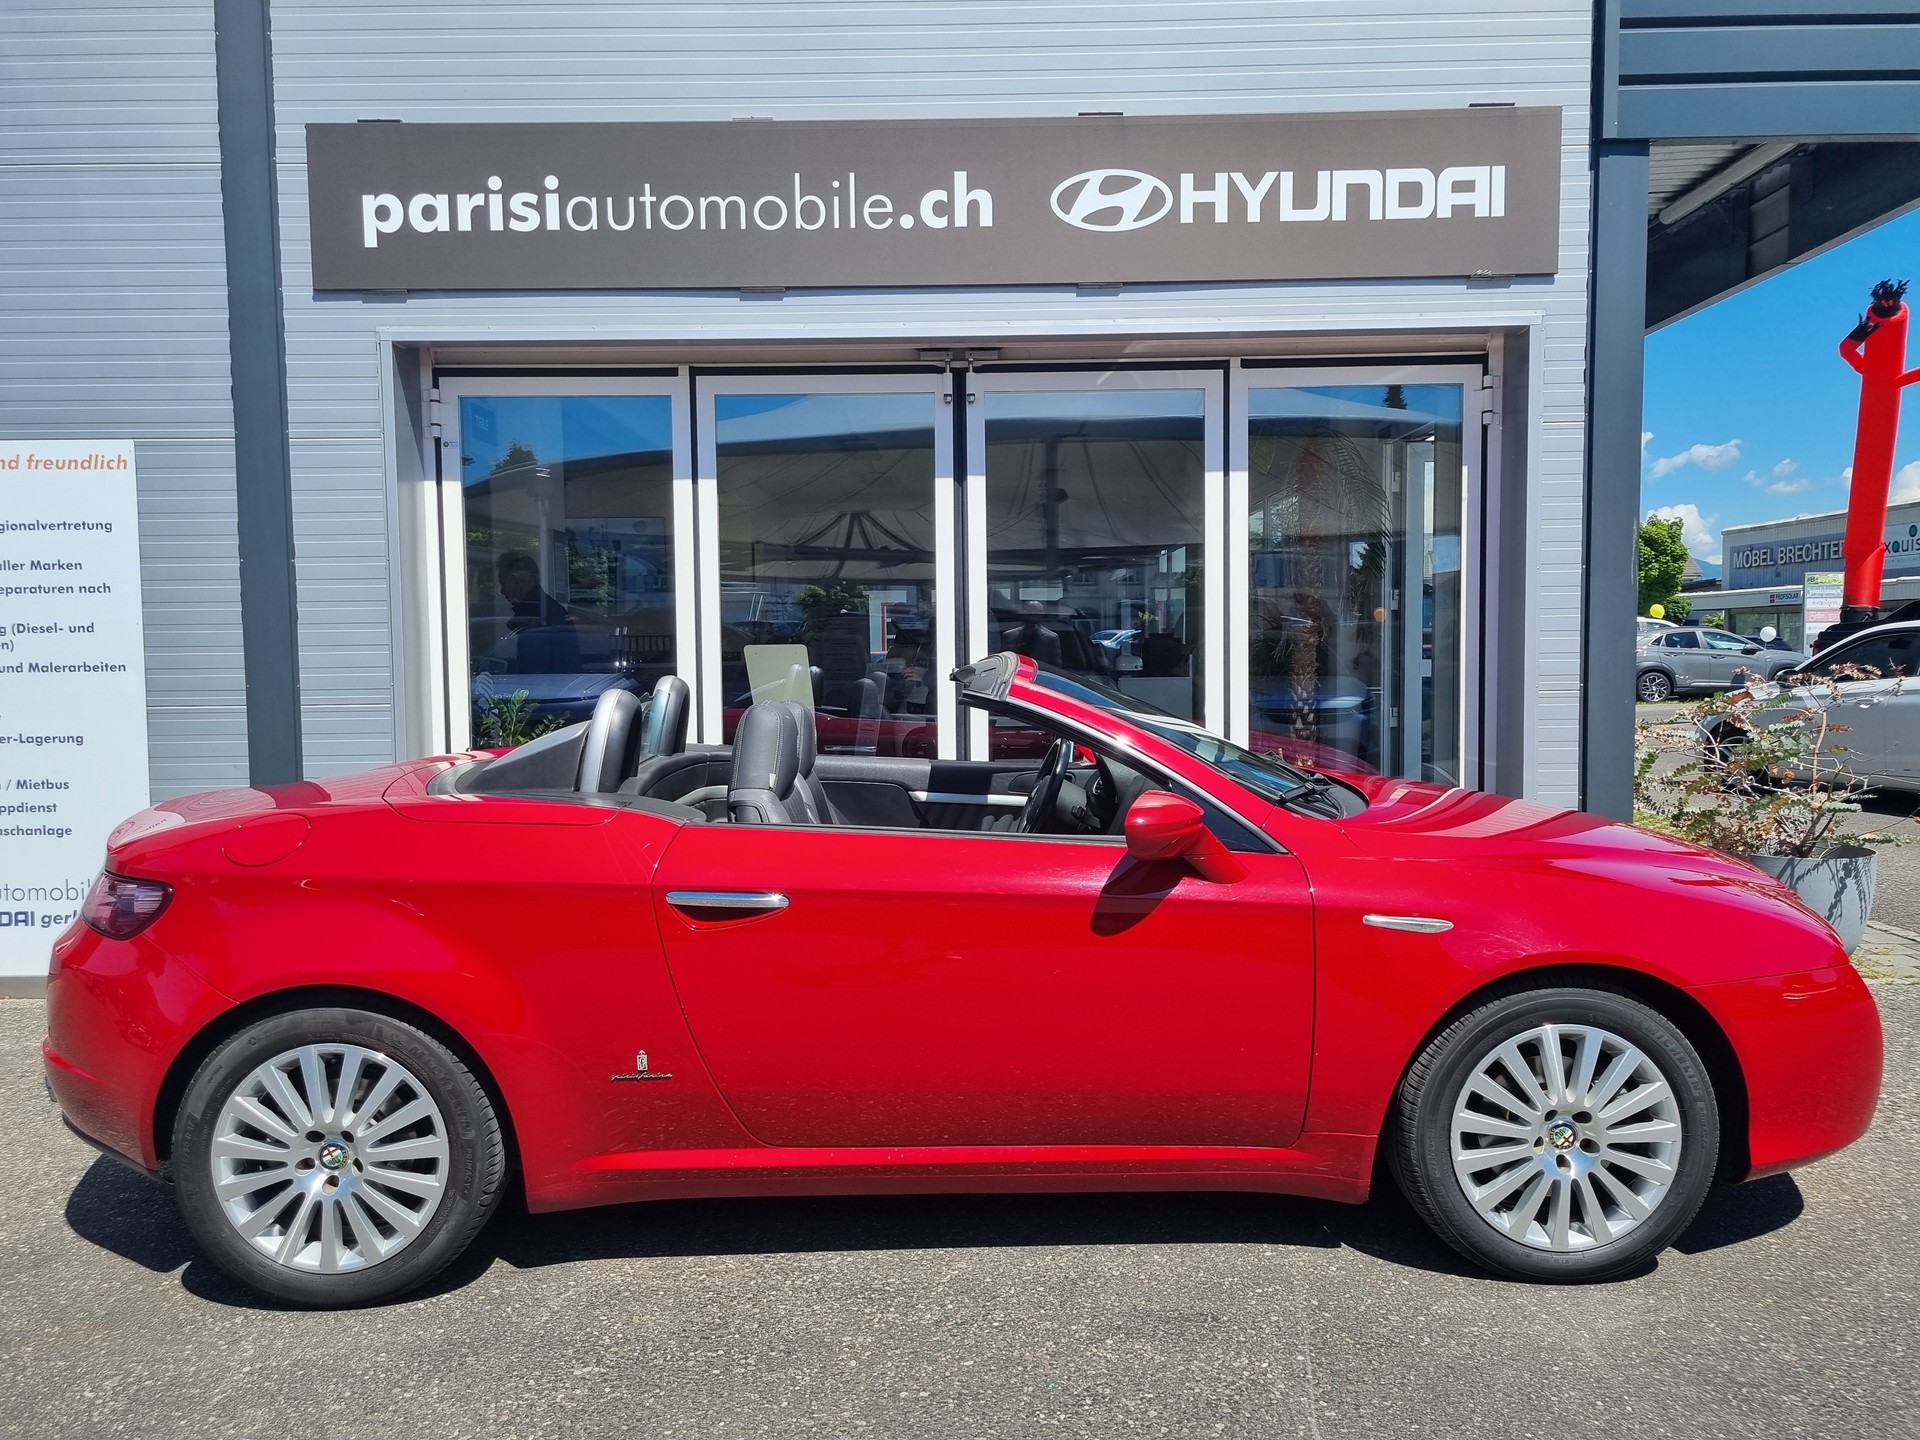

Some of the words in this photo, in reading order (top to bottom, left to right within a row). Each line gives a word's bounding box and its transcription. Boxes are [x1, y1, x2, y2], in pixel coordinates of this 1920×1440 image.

[361, 170, 993, 248] parisiautomobile.ch
[1180, 166, 1505, 224] HYUNDAI
[27, 454, 128, 470] freundlich
[1733, 547, 1774, 569] MÖBEL
[0, 559, 25, 571] ller
[30, 559, 83, 571] Marken
[79, 583, 111, 594] nach
[12, 622, 64, 636] (Diesel-
[69, 622, 95, 633] und
[28, 661, 126, 673] Malerarbeiten
[0, 733, 84, 746] er-Lagerung
[16, 779, 70, 790] Mietbus
[463, 1148, 474, 1189] PRIMACY
